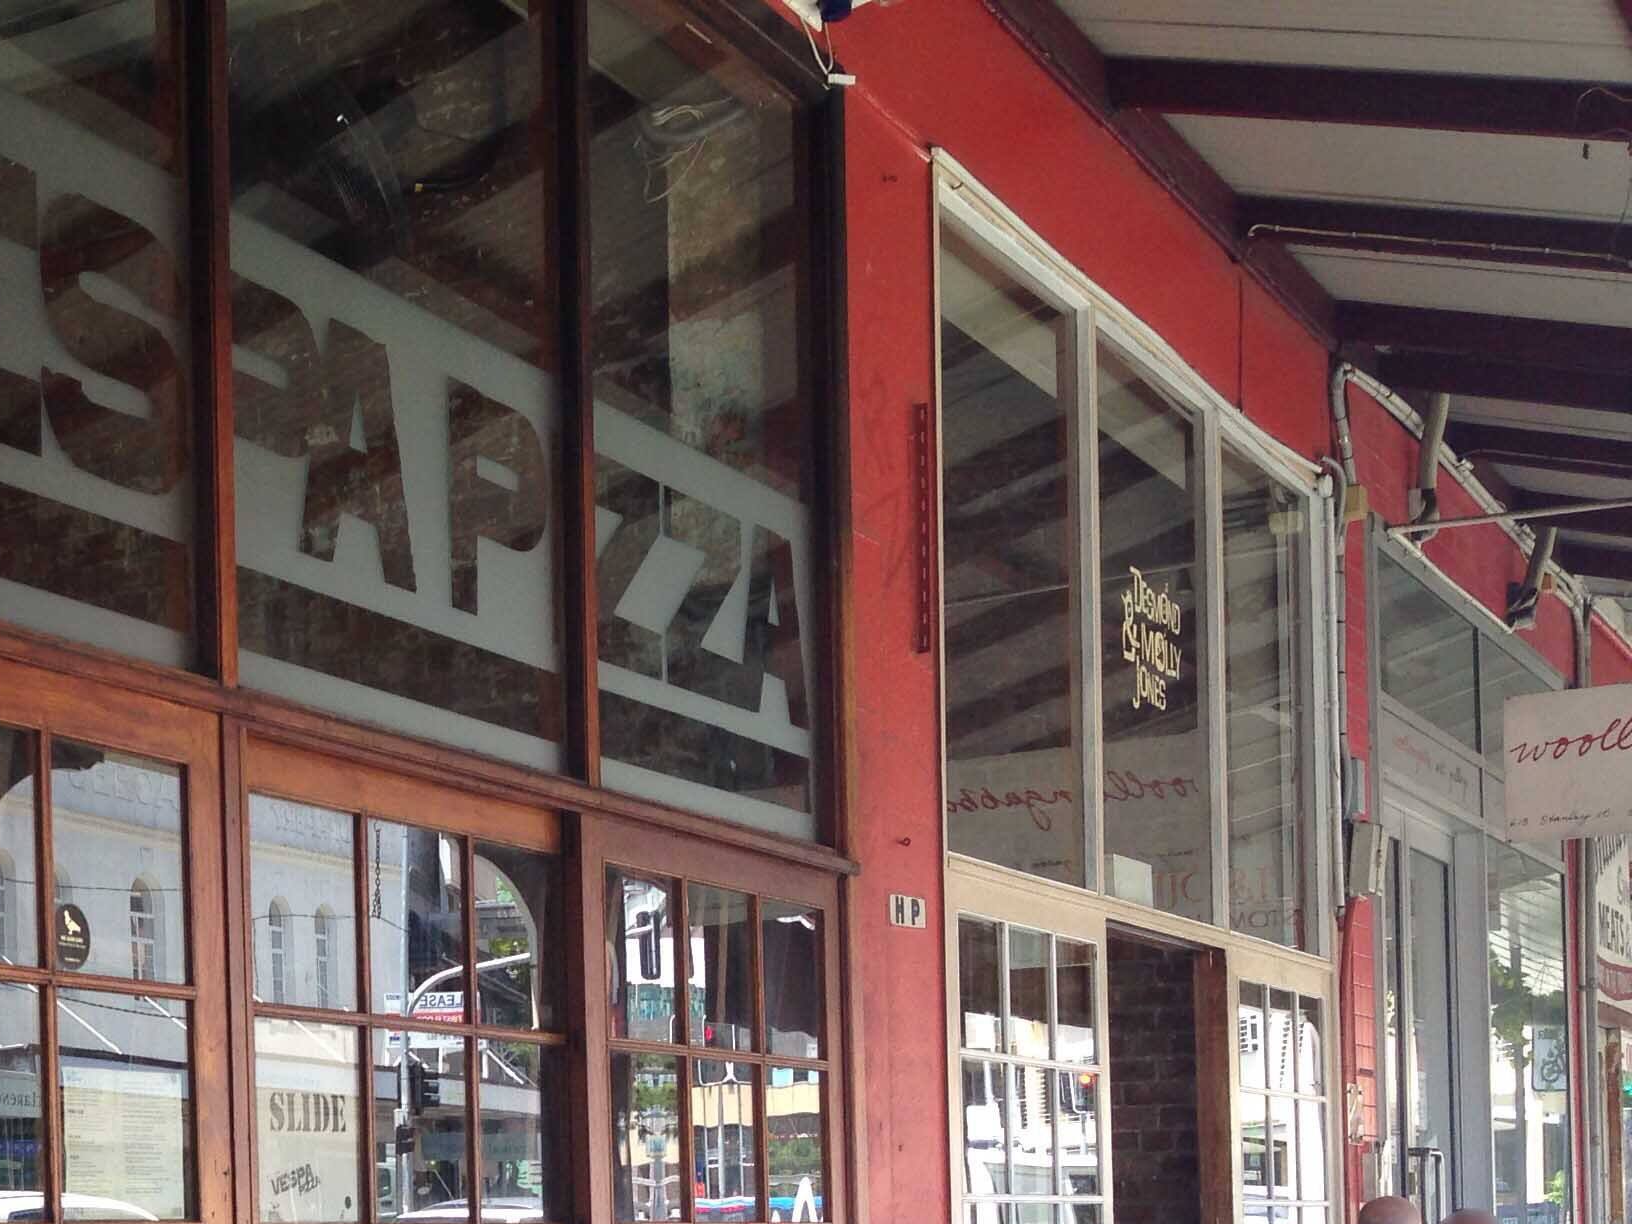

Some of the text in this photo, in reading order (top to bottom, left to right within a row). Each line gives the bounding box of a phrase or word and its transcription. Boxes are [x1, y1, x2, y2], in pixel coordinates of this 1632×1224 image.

[448, 376, 811, 732] PZZA
[1129, 566, 1181, 635] DESMOND
[1141, 622, 1182, 681] MOLLY
[1133, 655, 1167, 711] JONES
[269, 1091, 347, 1133] SLIDE
